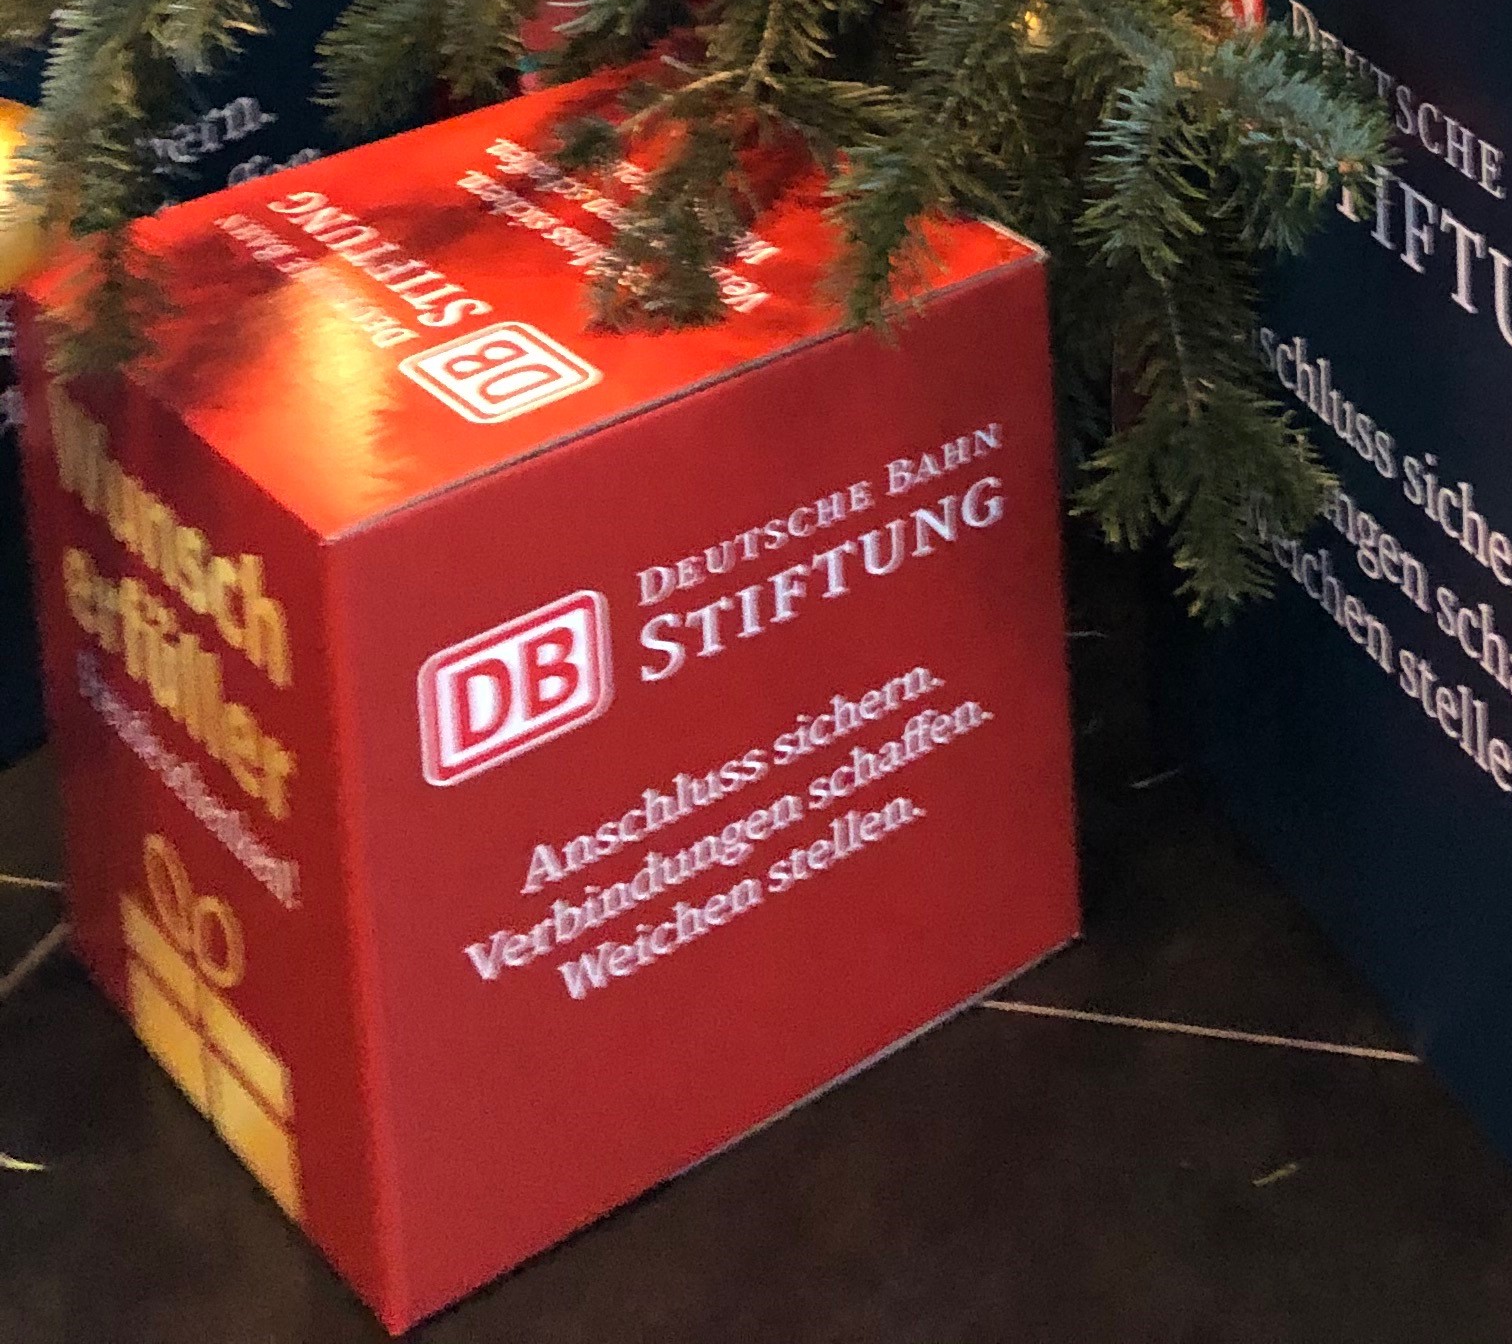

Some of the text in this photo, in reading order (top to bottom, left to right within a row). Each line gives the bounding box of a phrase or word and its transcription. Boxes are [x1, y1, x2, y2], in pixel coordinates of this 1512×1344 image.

[266, 190, 493, 327] STIFTUNG
[1258, 326, 1398, 480] schluss
[49, 378, 293, 689] Wunsch
[636, 421, 1002, 608] DEUTSCHE BAHN
[639, 475, 1005, 683] STIFTUNG
[463, 699, 994, 982] Verbindungen schaffen.
[520, 664, 946, 896] Anschluss sichern.
[559, 792, 928, 1001] Weichen stellen.
